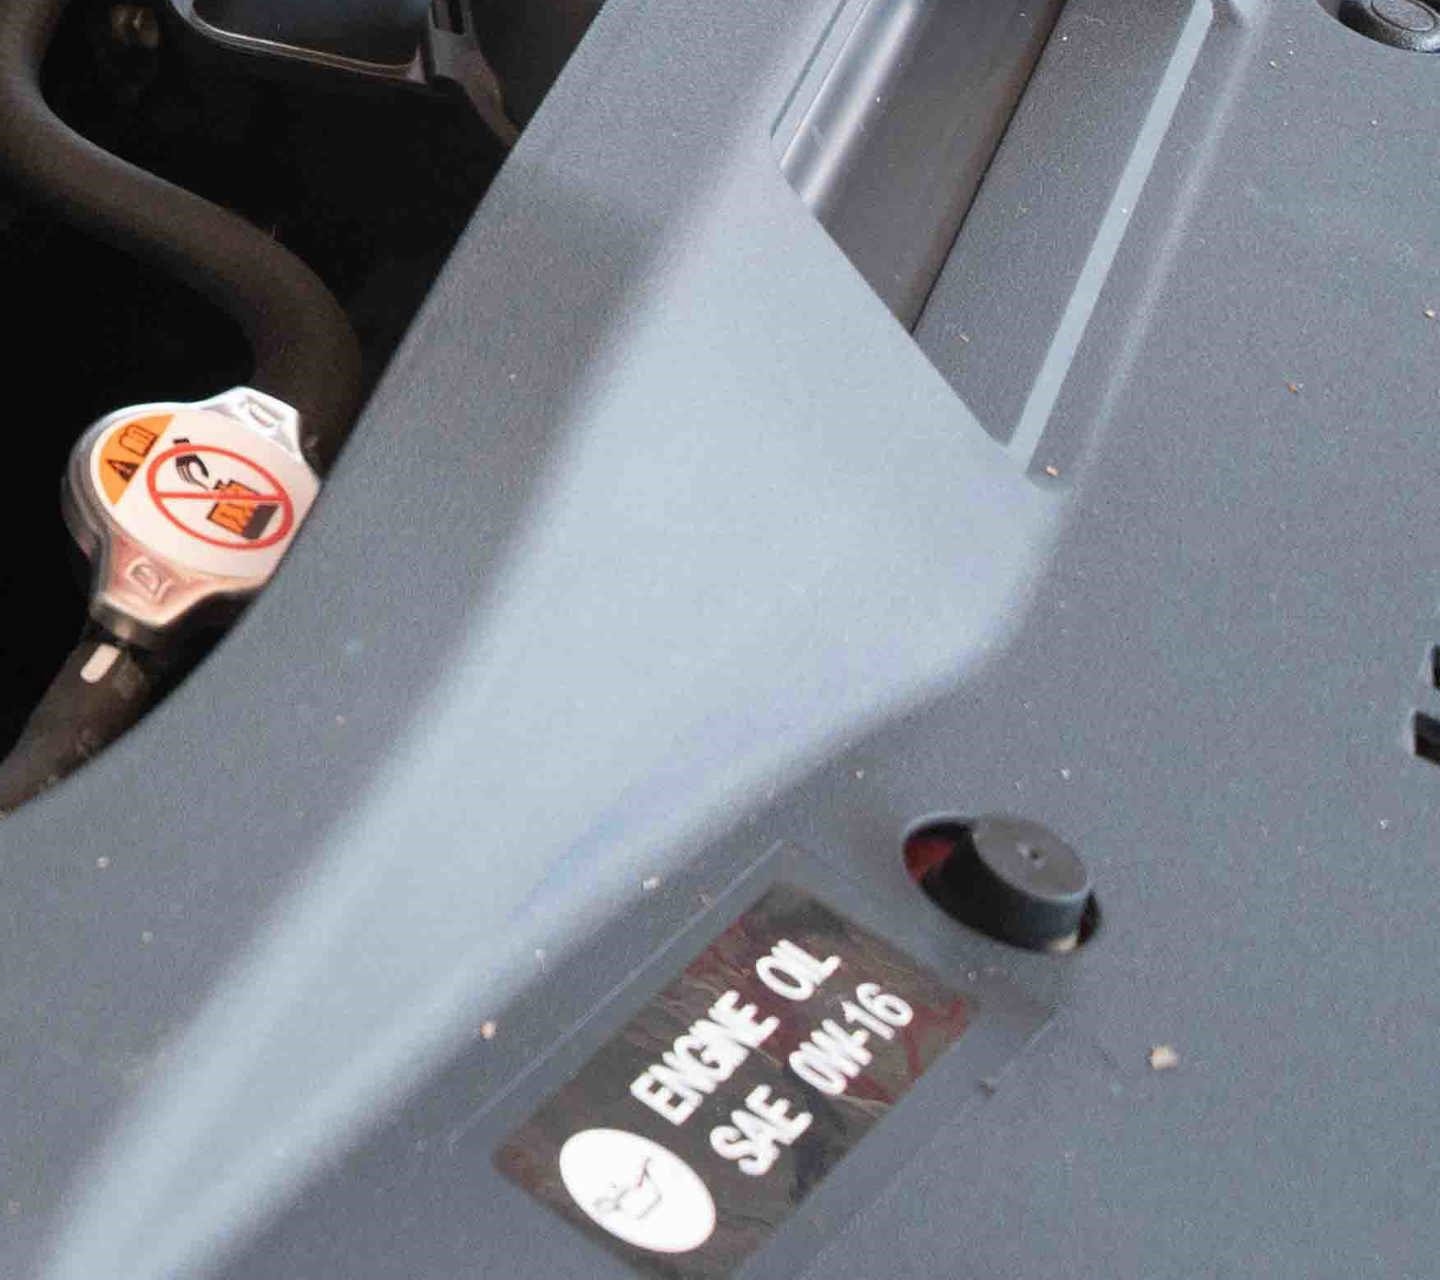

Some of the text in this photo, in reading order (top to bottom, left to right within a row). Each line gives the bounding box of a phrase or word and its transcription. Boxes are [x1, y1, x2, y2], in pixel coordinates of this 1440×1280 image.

[629, 939, 842, 1126] ENGINE OIL
[709, 1084, 814, 1177] SAE
